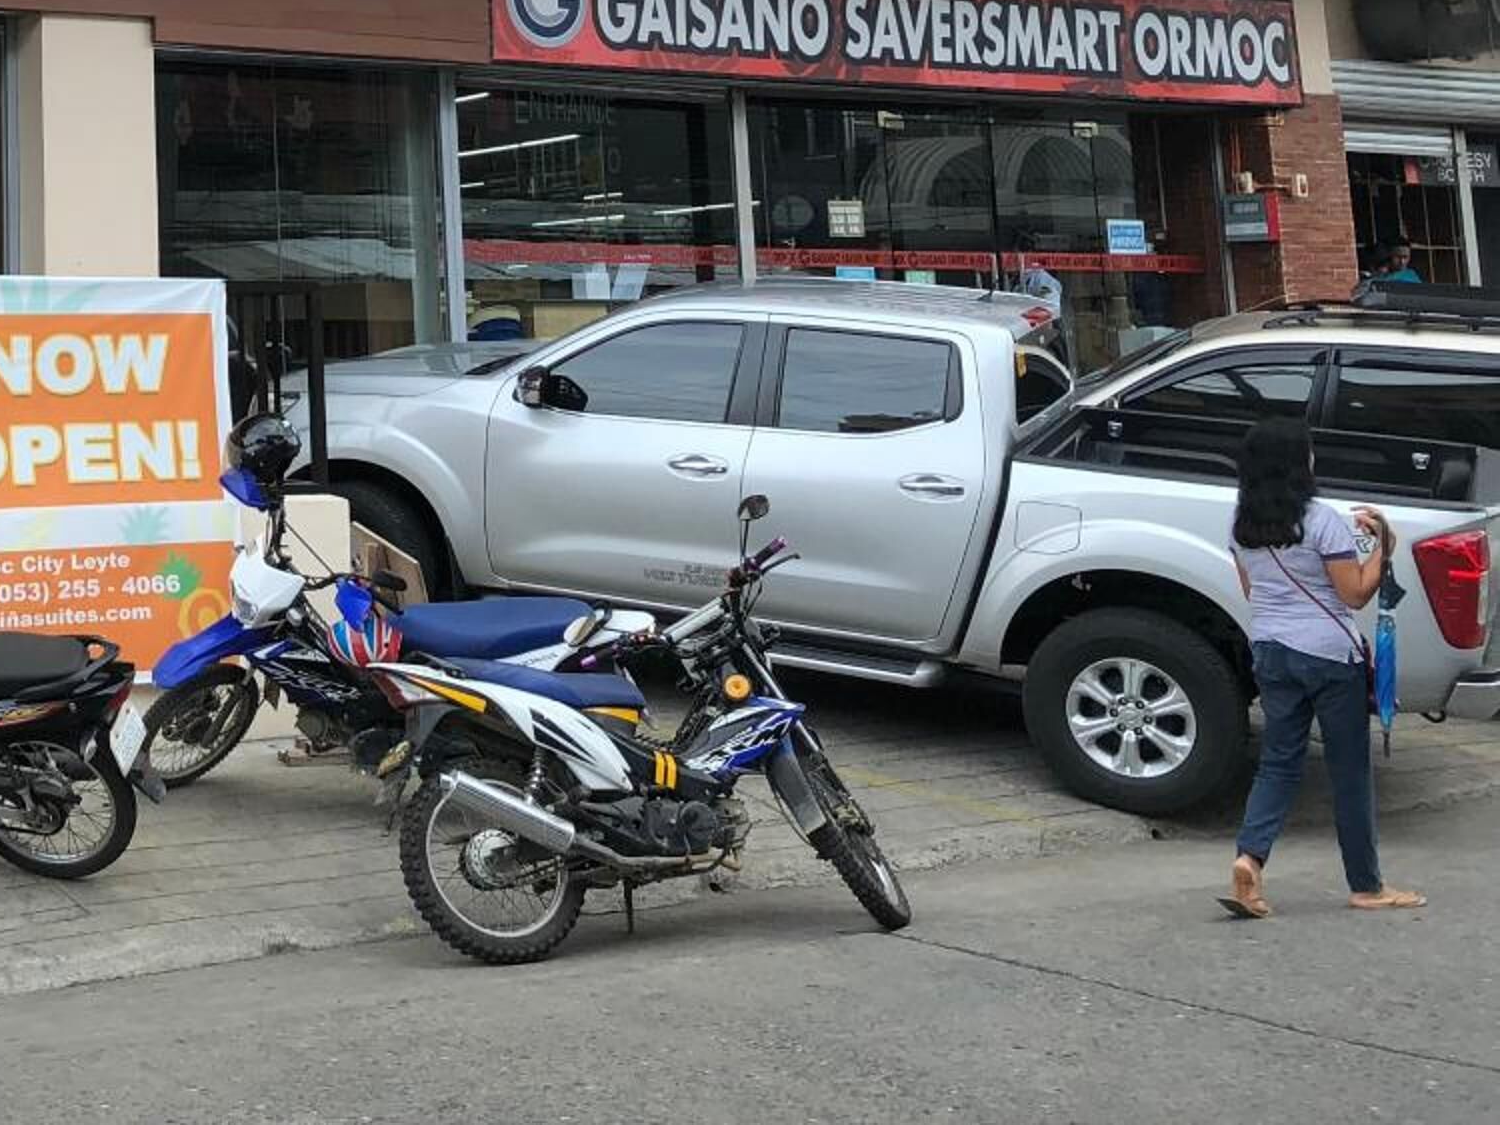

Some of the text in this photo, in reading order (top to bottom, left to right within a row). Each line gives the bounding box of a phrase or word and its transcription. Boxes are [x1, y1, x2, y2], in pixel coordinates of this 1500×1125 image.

[1134, 15, 1288, 84] ORMOC
[21, 554, 64, 575] City
[71, 552, 131, 573] Leyte
[57, 577, 101, 600] 255
[121, 573, 181, 596] 4066
